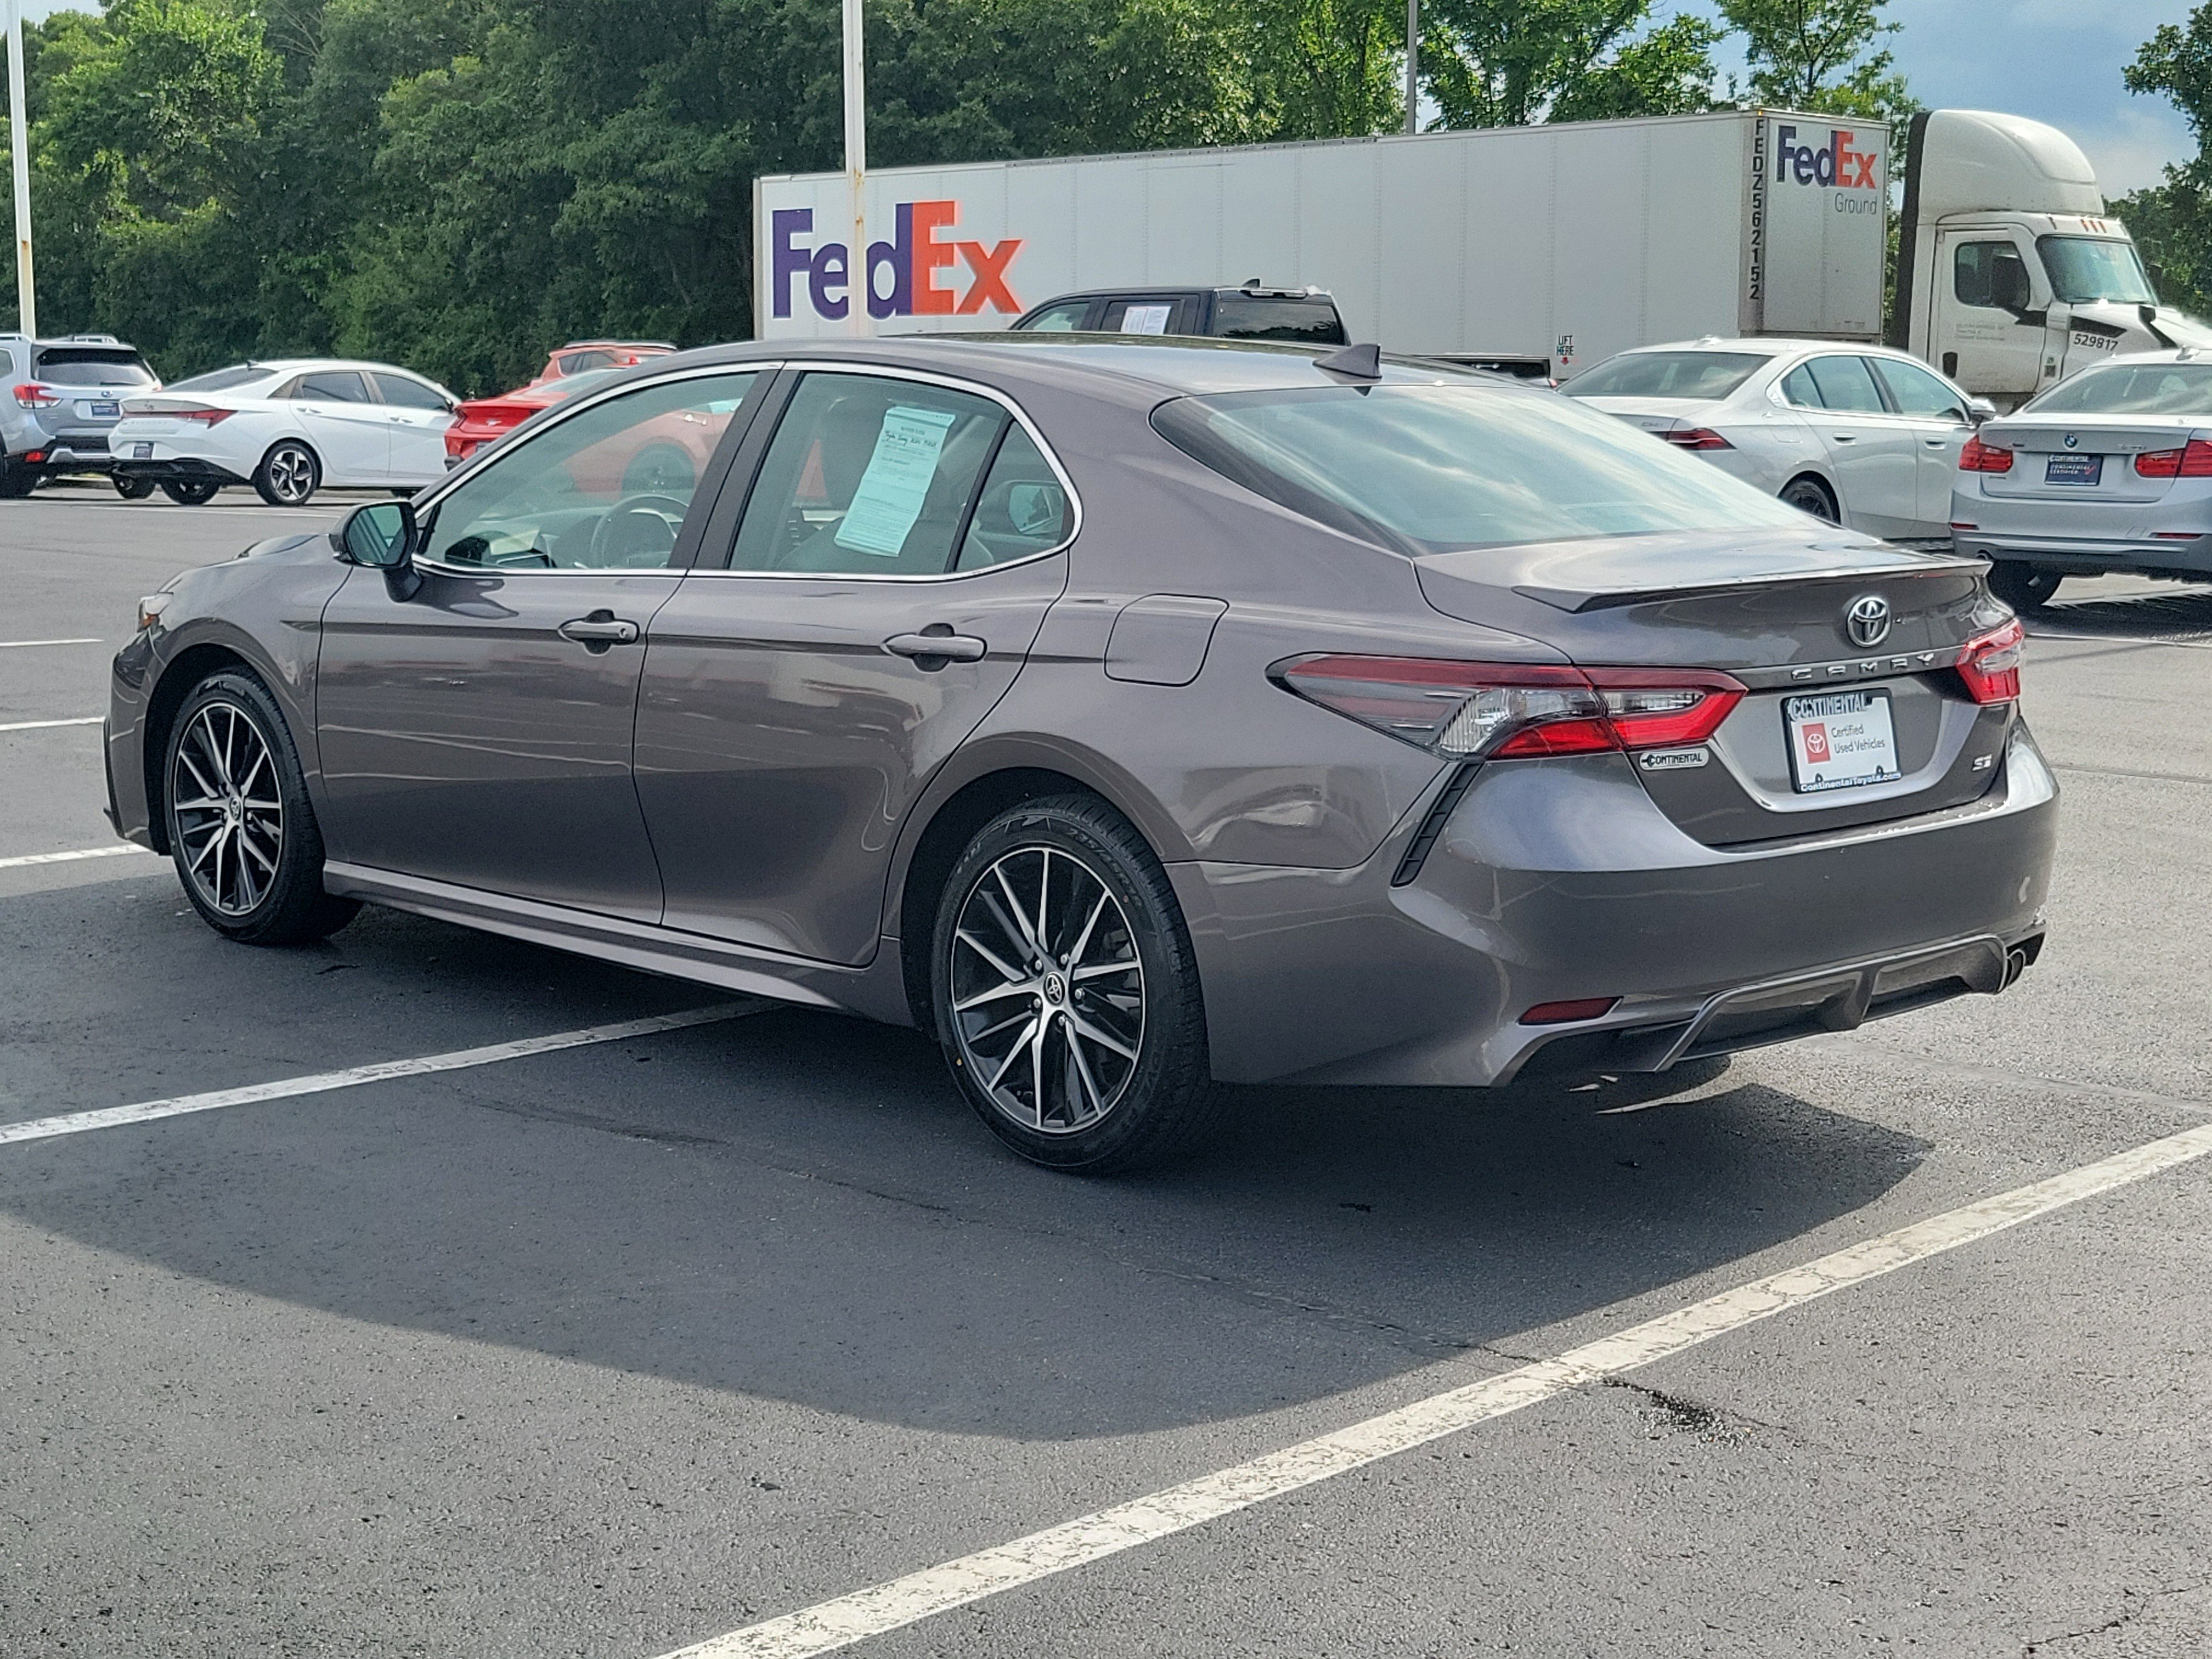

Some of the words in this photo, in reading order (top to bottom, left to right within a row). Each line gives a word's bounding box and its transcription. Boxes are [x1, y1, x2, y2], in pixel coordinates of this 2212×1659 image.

[1777, 125, 1877, 189] FedEx
[1835, 193, 1877, 215] Ground
[772, 201, 1023, 321] FedEx
[1556, 346, 1573, 356] HERE
[2073, 333, 2119, 352] 529817
[1791, 653, 1934, 680] CAMRY
[1789, 692, 1866, 721] CONTINENTAL
[1831, 724, 1864, 738] Certified
[1834, 741, 1854, 754] Used
[1854, 738, 1886, 751] Vehicles
[1641, 753, 1702, 767] CONTINENTAL
